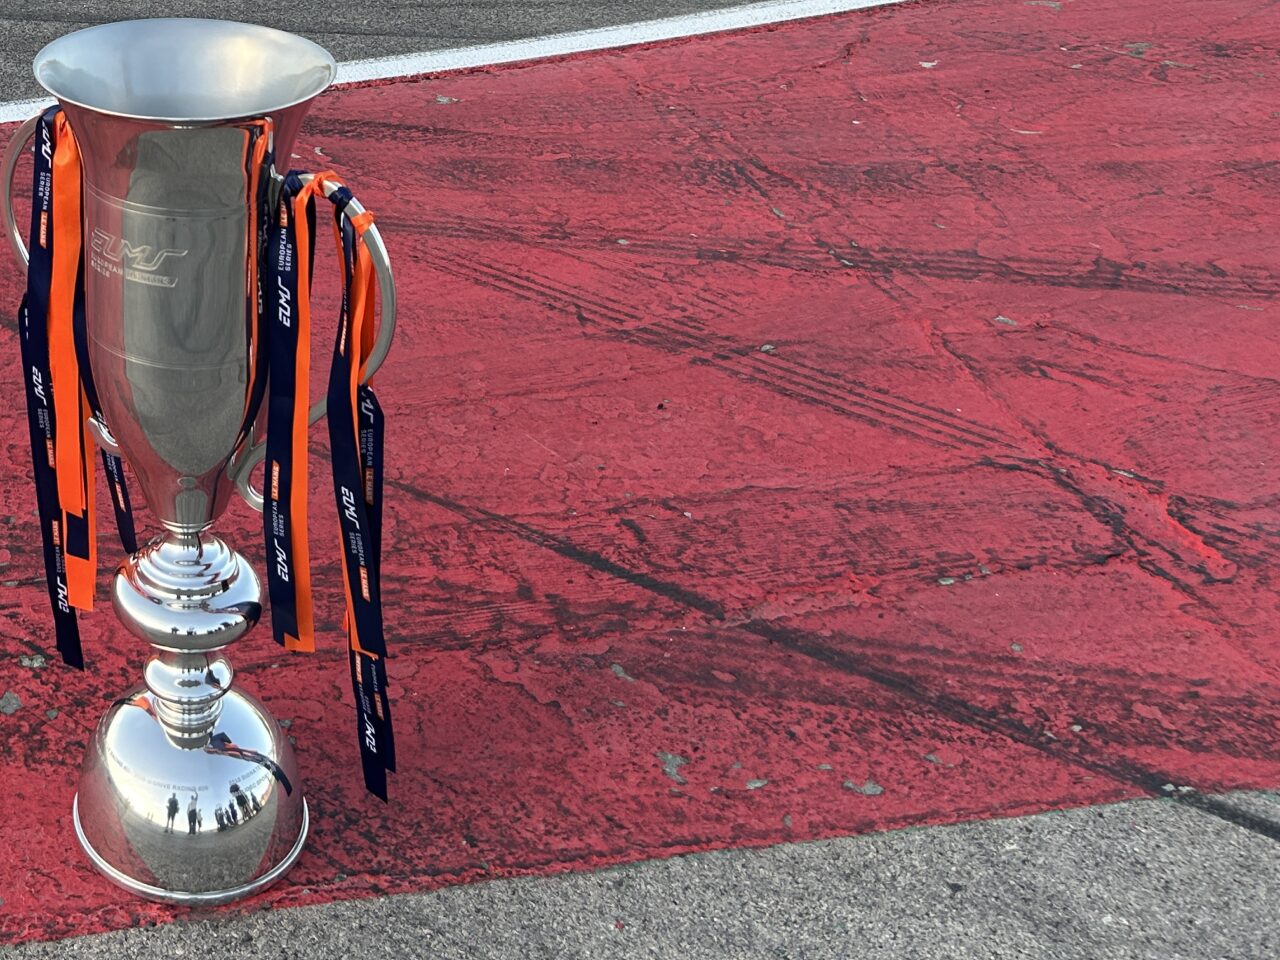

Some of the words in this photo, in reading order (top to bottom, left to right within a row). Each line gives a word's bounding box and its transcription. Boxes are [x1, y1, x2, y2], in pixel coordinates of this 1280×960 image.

[278, 228, 287, 271] EUROPEAN
[285, 243, 293, 272] SERIES
[278, 275, 291, 328] ELMS
[32, 365, 48, 406] ELMS
[341, 485, 360, 530] ELMS
[274, 537, 289, 582] ELMS
[57, 576, 70, 614] ELMS
[364, 712, 378, 754] ELMS
